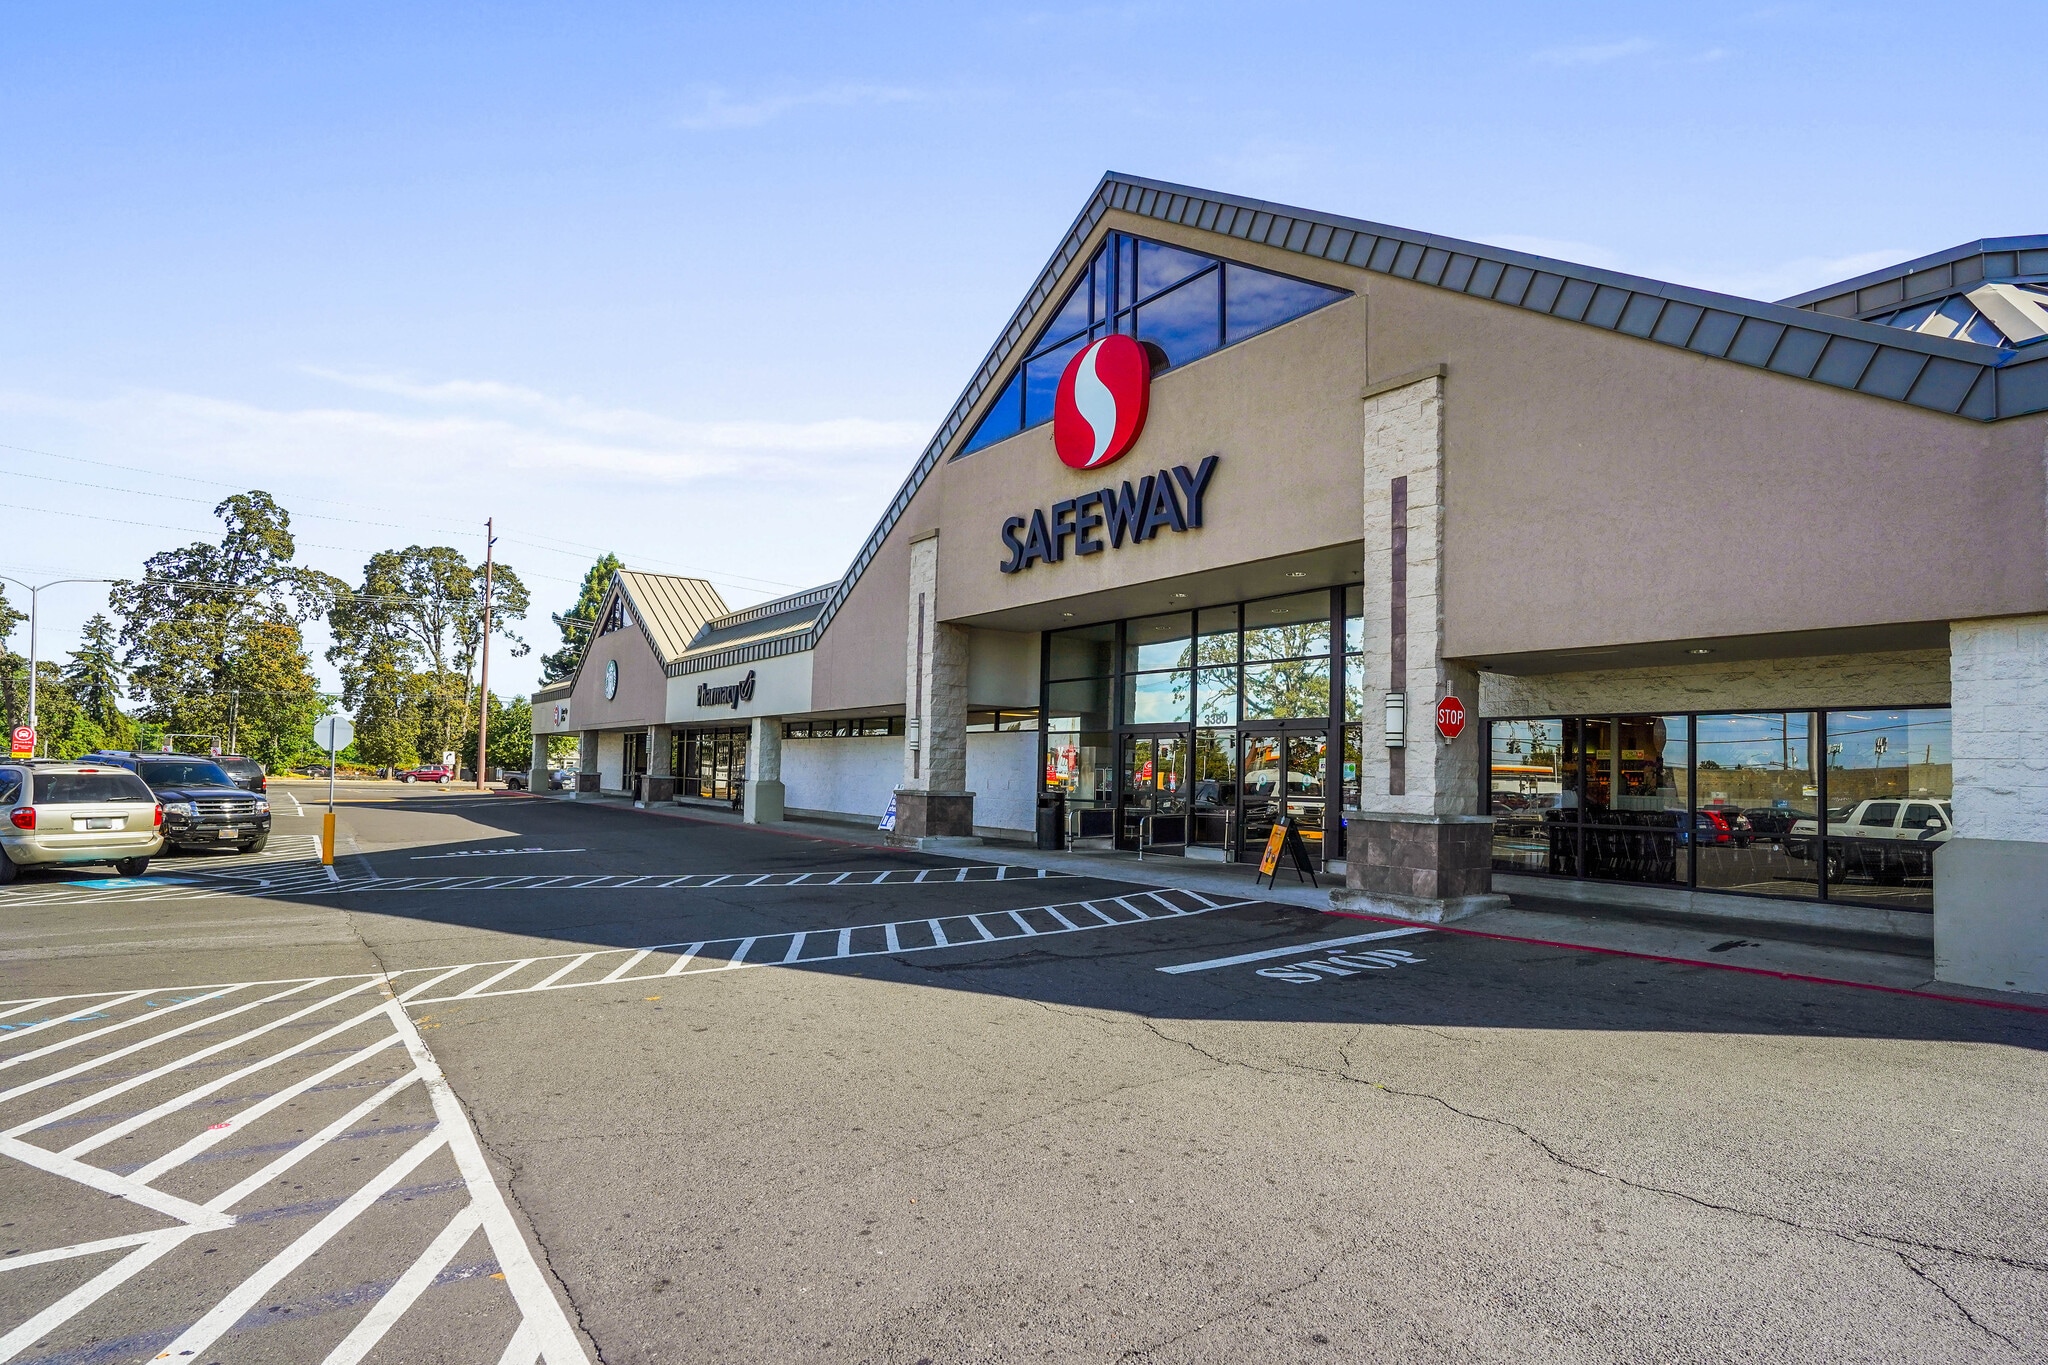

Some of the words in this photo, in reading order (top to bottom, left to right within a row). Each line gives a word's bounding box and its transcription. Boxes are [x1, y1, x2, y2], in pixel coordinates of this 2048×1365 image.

[1000, 455, 1219, 574] SAFEWAY
[697, 682, 739, 710] Pharmacy
[1204, 712, 1228, 726] 3380
[1438, 708, 1464, 726] STOP
[1255, 949, 1427, 984] STOP
